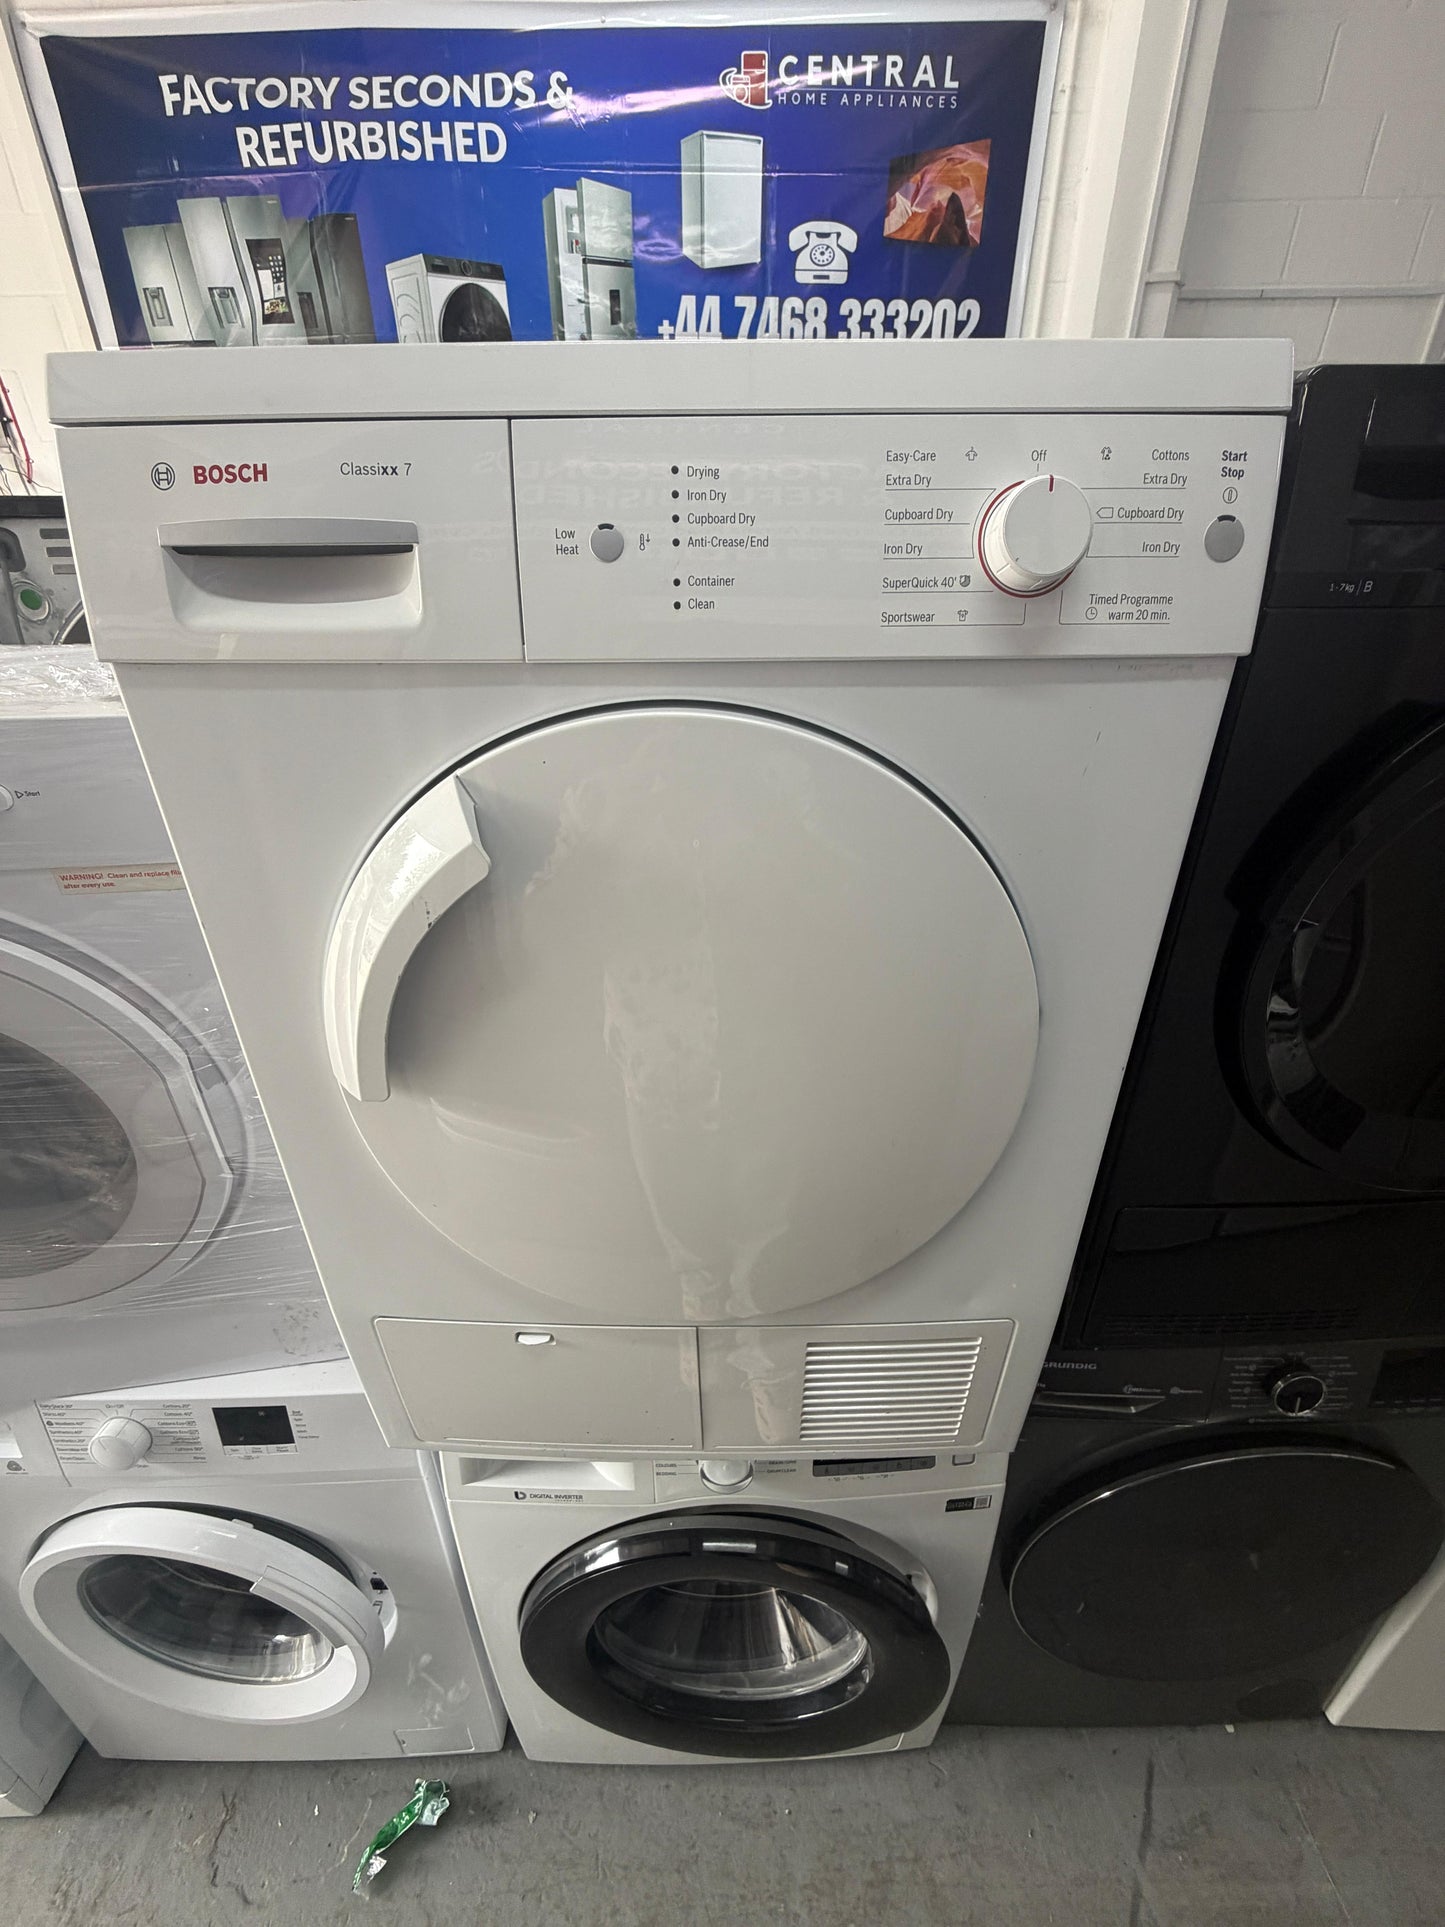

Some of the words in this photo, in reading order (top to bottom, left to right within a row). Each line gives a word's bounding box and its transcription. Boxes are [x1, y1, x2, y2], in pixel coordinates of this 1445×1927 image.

[778, 54, 960, 88] CENTRAL
[158, 74, 340, 116] FACTORY
[348, 70, 536, 110] SECONDS
[546, 71, 573, 110] &
[778, 92, 827, 105] HOME
[840, 93, 958, 109] APPLIANCES
[235, 120, 508, 168] REFURBISHED
[735, 296, 828, 340] 7468
[838, 298, 981, 340] 333202
[886, 449, 937, 464] Easy-Care
[1031, 450, 1047, 462] Off
[1151, 449, 1190, 461] Cottons
[1221, 450, 1248, 462] Start
[193, 463, 268, 485] BOSCH
[340, 462, 399, 476] Classixx
[404, 462, 412, 476] 7
[687, 465, 720, 480] Drying
[1220, 466, 1245, 480] Stop
[885, 473, 912, 486] Extra
[914, 474, 932, 488] Dry
[1143, 473, 1169, 485] Extra
[1172, 473, 1188, 487] Dry
[687, 489, 707, 501] Iron
[709, 489, 727, 504] Dry
[687, 512, 736, 527] Cupboard
[738, 512, 756, 527] Dry
[884, 508, 934, 522] Cupboard
[936, 508, 954, 522] Dry
[1117, 507, 1165, 521] Cupboard
[1167, 507, 1184, 521] Dry
[555, 528, 575, 540] Low
[555, 544, 580, 555] Heat
[687, 535, 769, 550] Anti-Crease/End
[1142, 541, 1161, 553] Iron
[1163, 541, 1181, 556] Dry
[883, 543, 903, 555] Iron
[905, 543, 923, 557] Dry
[687, 575, 735, 587] Container
[882, 576, 938, 590] SuperQuick
[687, 598, 715, 610] Clean
[1089, 593, 1118, 605] Timed
[1120, 593, 1174, 608] Programme
[881, 611, 935, 625] Sportswear
[1108, 611, 1134, 620] warm
[1136, 609, 1148, 620] 20
[1150, 609, 1170, 620] min.
[60, 873, 104, 882] WARNING!
[143, 871, 169, 880] replace
[63, 881, 80, 889] after
[82, 881, 100, 890] every
